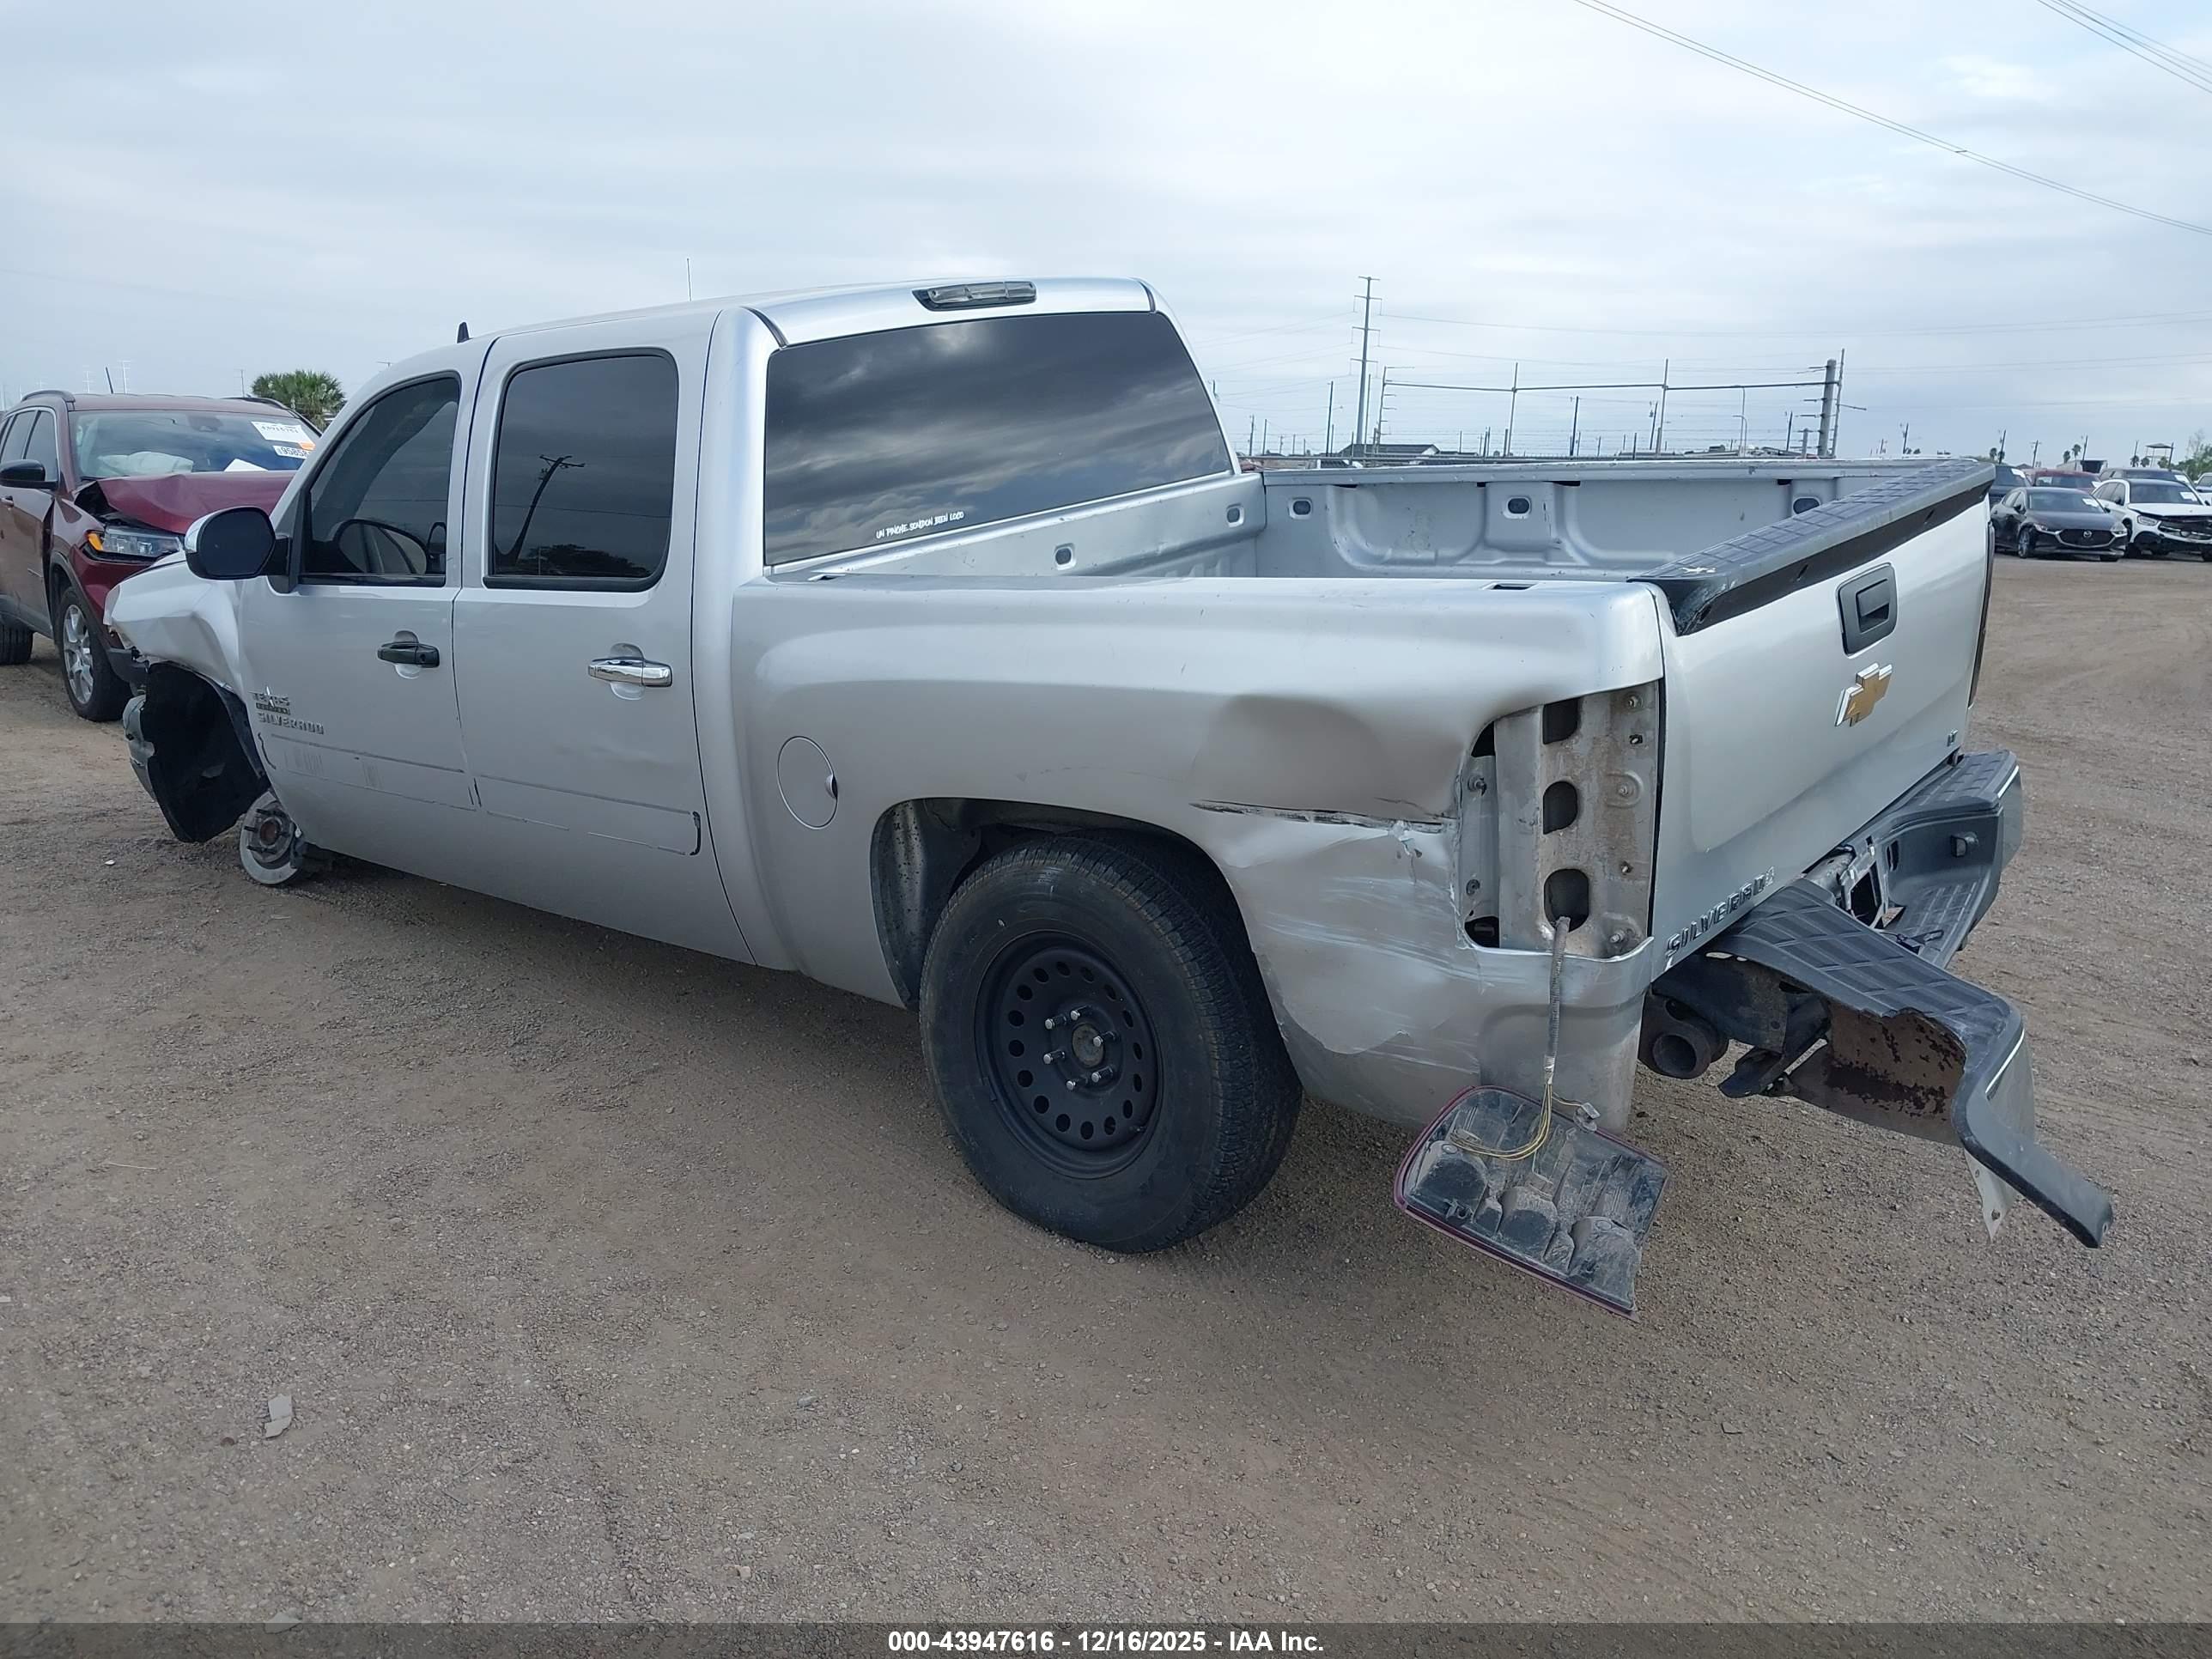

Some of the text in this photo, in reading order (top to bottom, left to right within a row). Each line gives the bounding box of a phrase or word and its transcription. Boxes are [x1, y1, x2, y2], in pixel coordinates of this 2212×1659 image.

[876, 528, 885, 539] UN
[949, 511, 964, 521] LOCO
[258, 712, 325, 735] SILVERADO
[1665, 866, 1775, 958] SILVERADO
